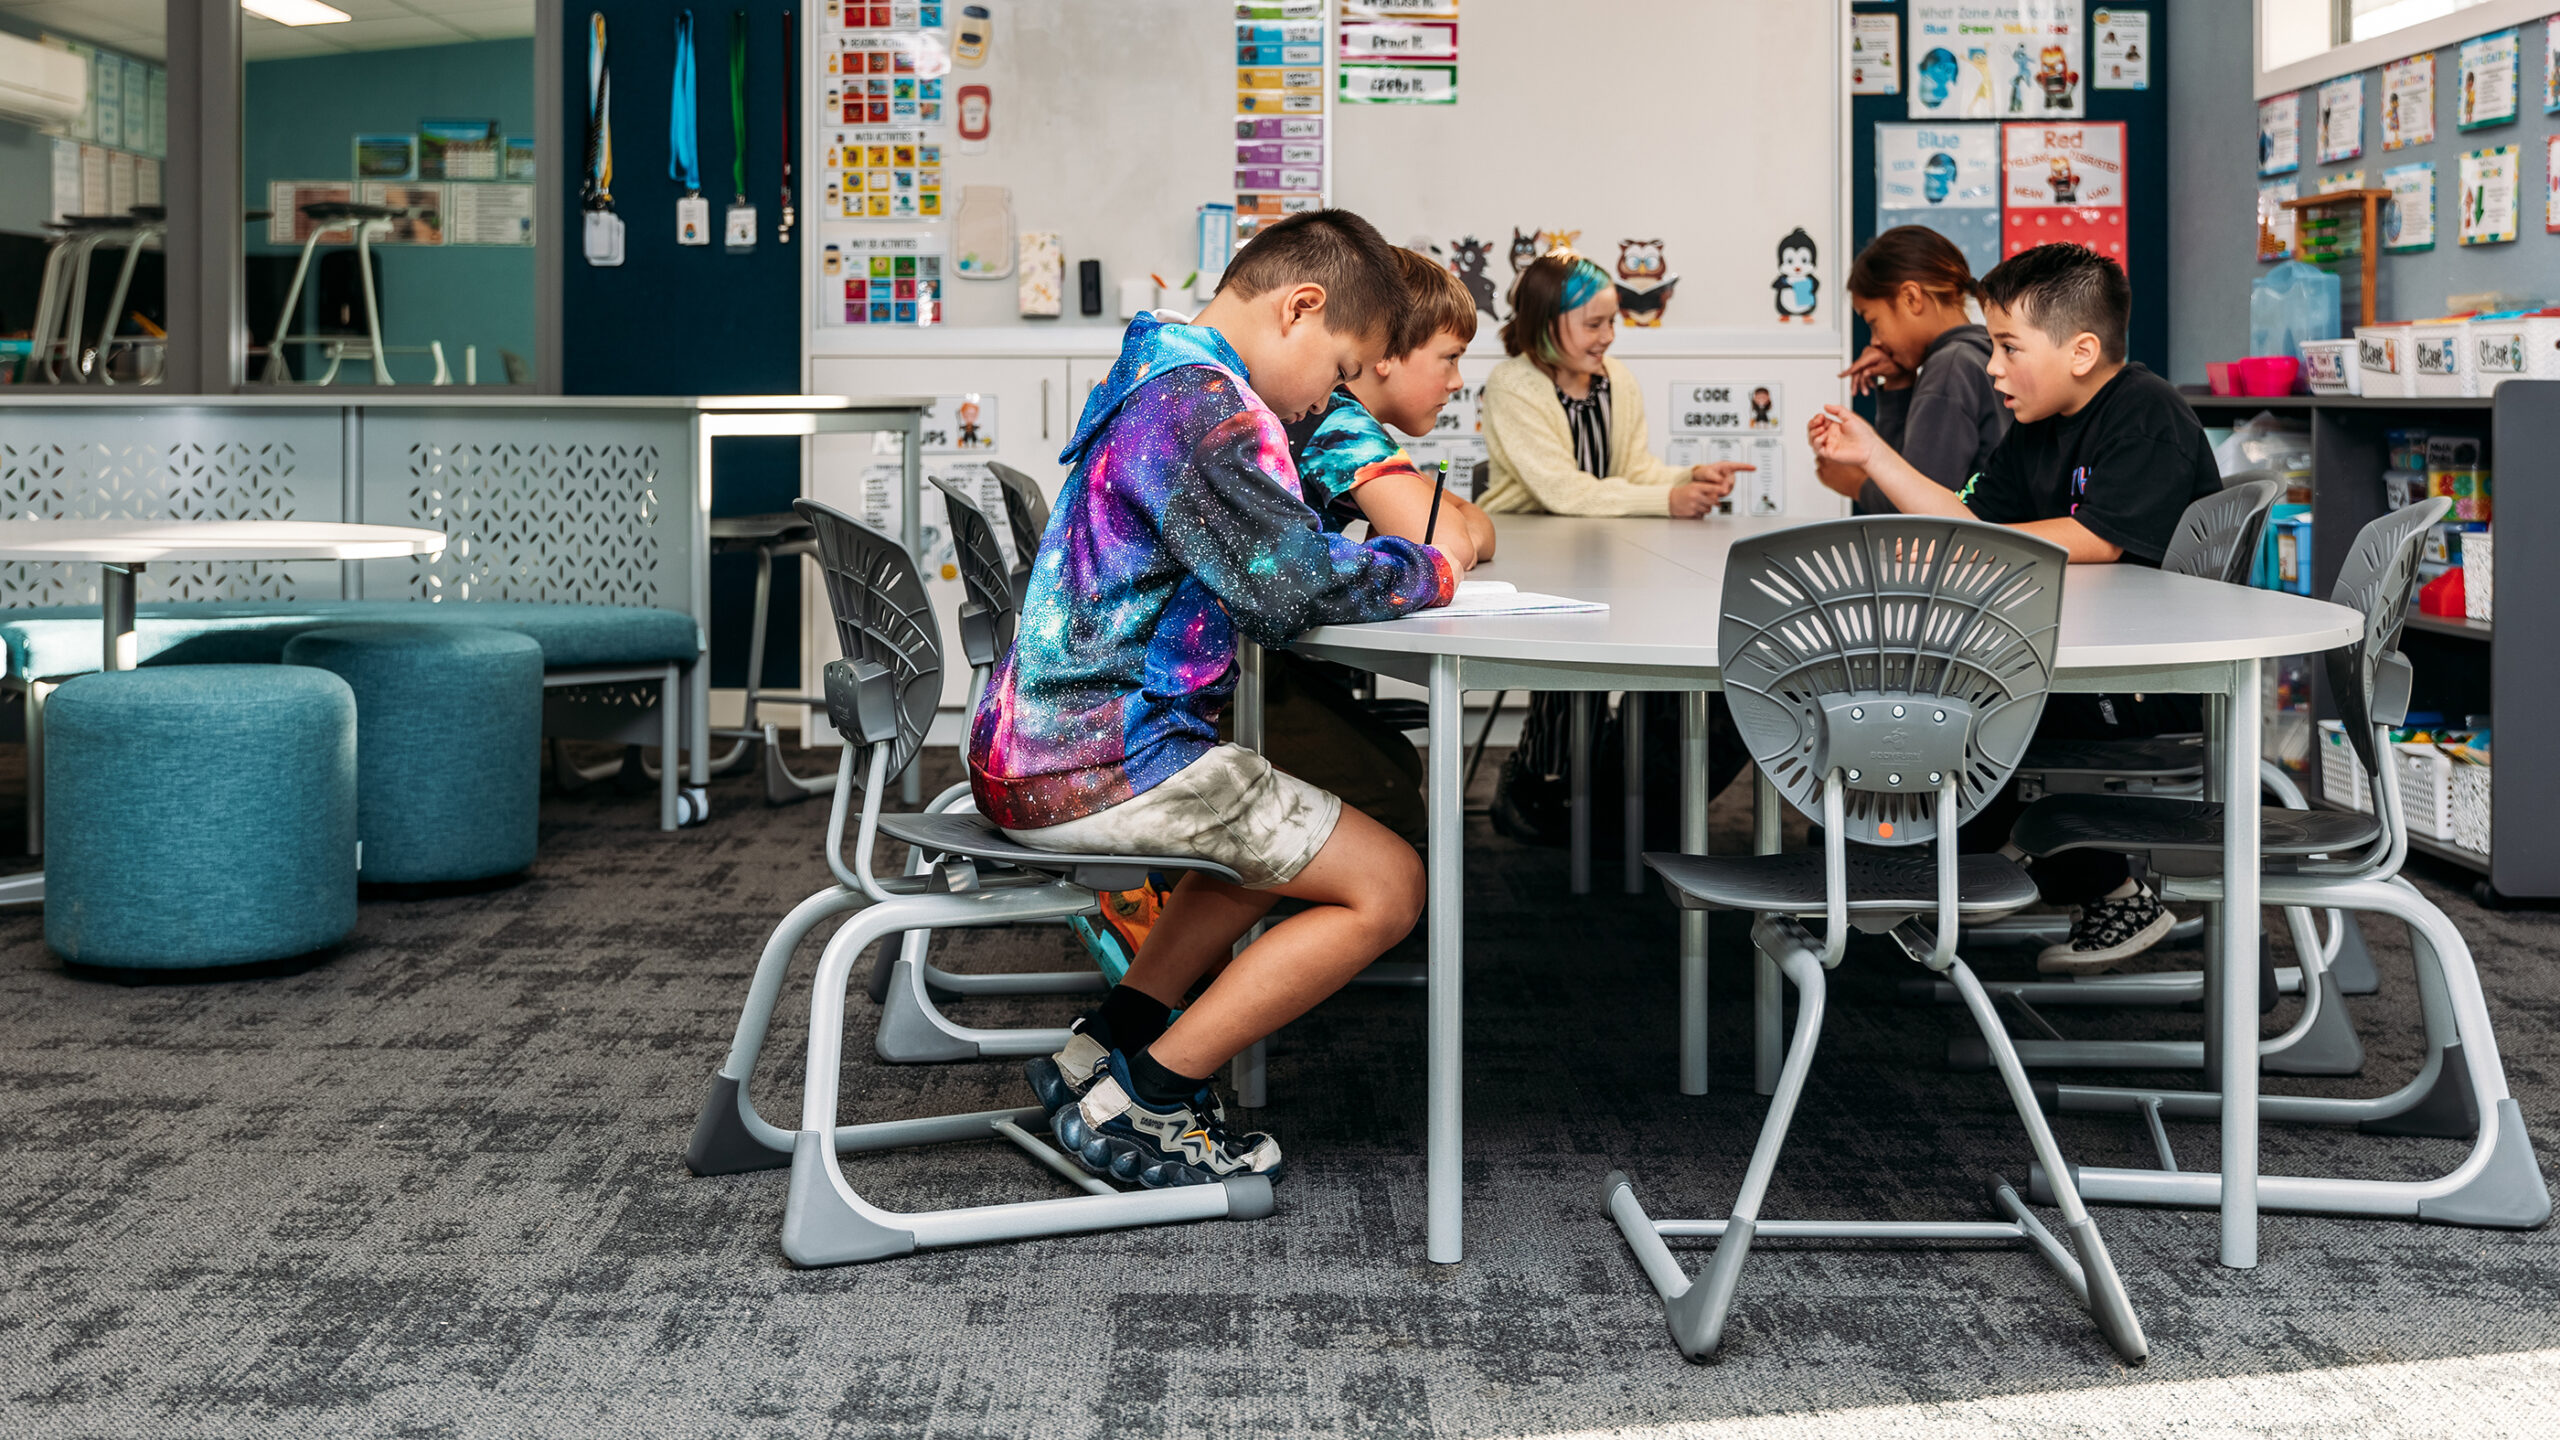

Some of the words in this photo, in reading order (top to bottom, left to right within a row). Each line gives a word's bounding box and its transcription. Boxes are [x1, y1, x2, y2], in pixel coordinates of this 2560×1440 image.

[1919, 8, 1953, 19] What
[1959, 8, 1991, 19] Zone
[1995, 8, 2019, 19] Are
[1924, 24, 1948, 35] Blue
[1958, 24, 1994, 36] Green
[2048, 24, 2069, 35] Red
[1917, 131, 1960, 149] Blue
[2044, 130, 2083, 149] Red
[2014, 187, 2044, 200] MEAN
[2086, 185, 2110, 201] MAD
[2360, 339, 2384, 366] Stage
[2384, 337, 2396, 373] 4
[2416, 342, 2442, 370] Stage
[2443, 337, 2455, 374] 5
[2480, 339, 2509, 367] Stage
[2511, 333, 2522, 372] 6
[1692, 388, 1731, 403] CODE
[1684, 412, 1740, 427] GROUPS
